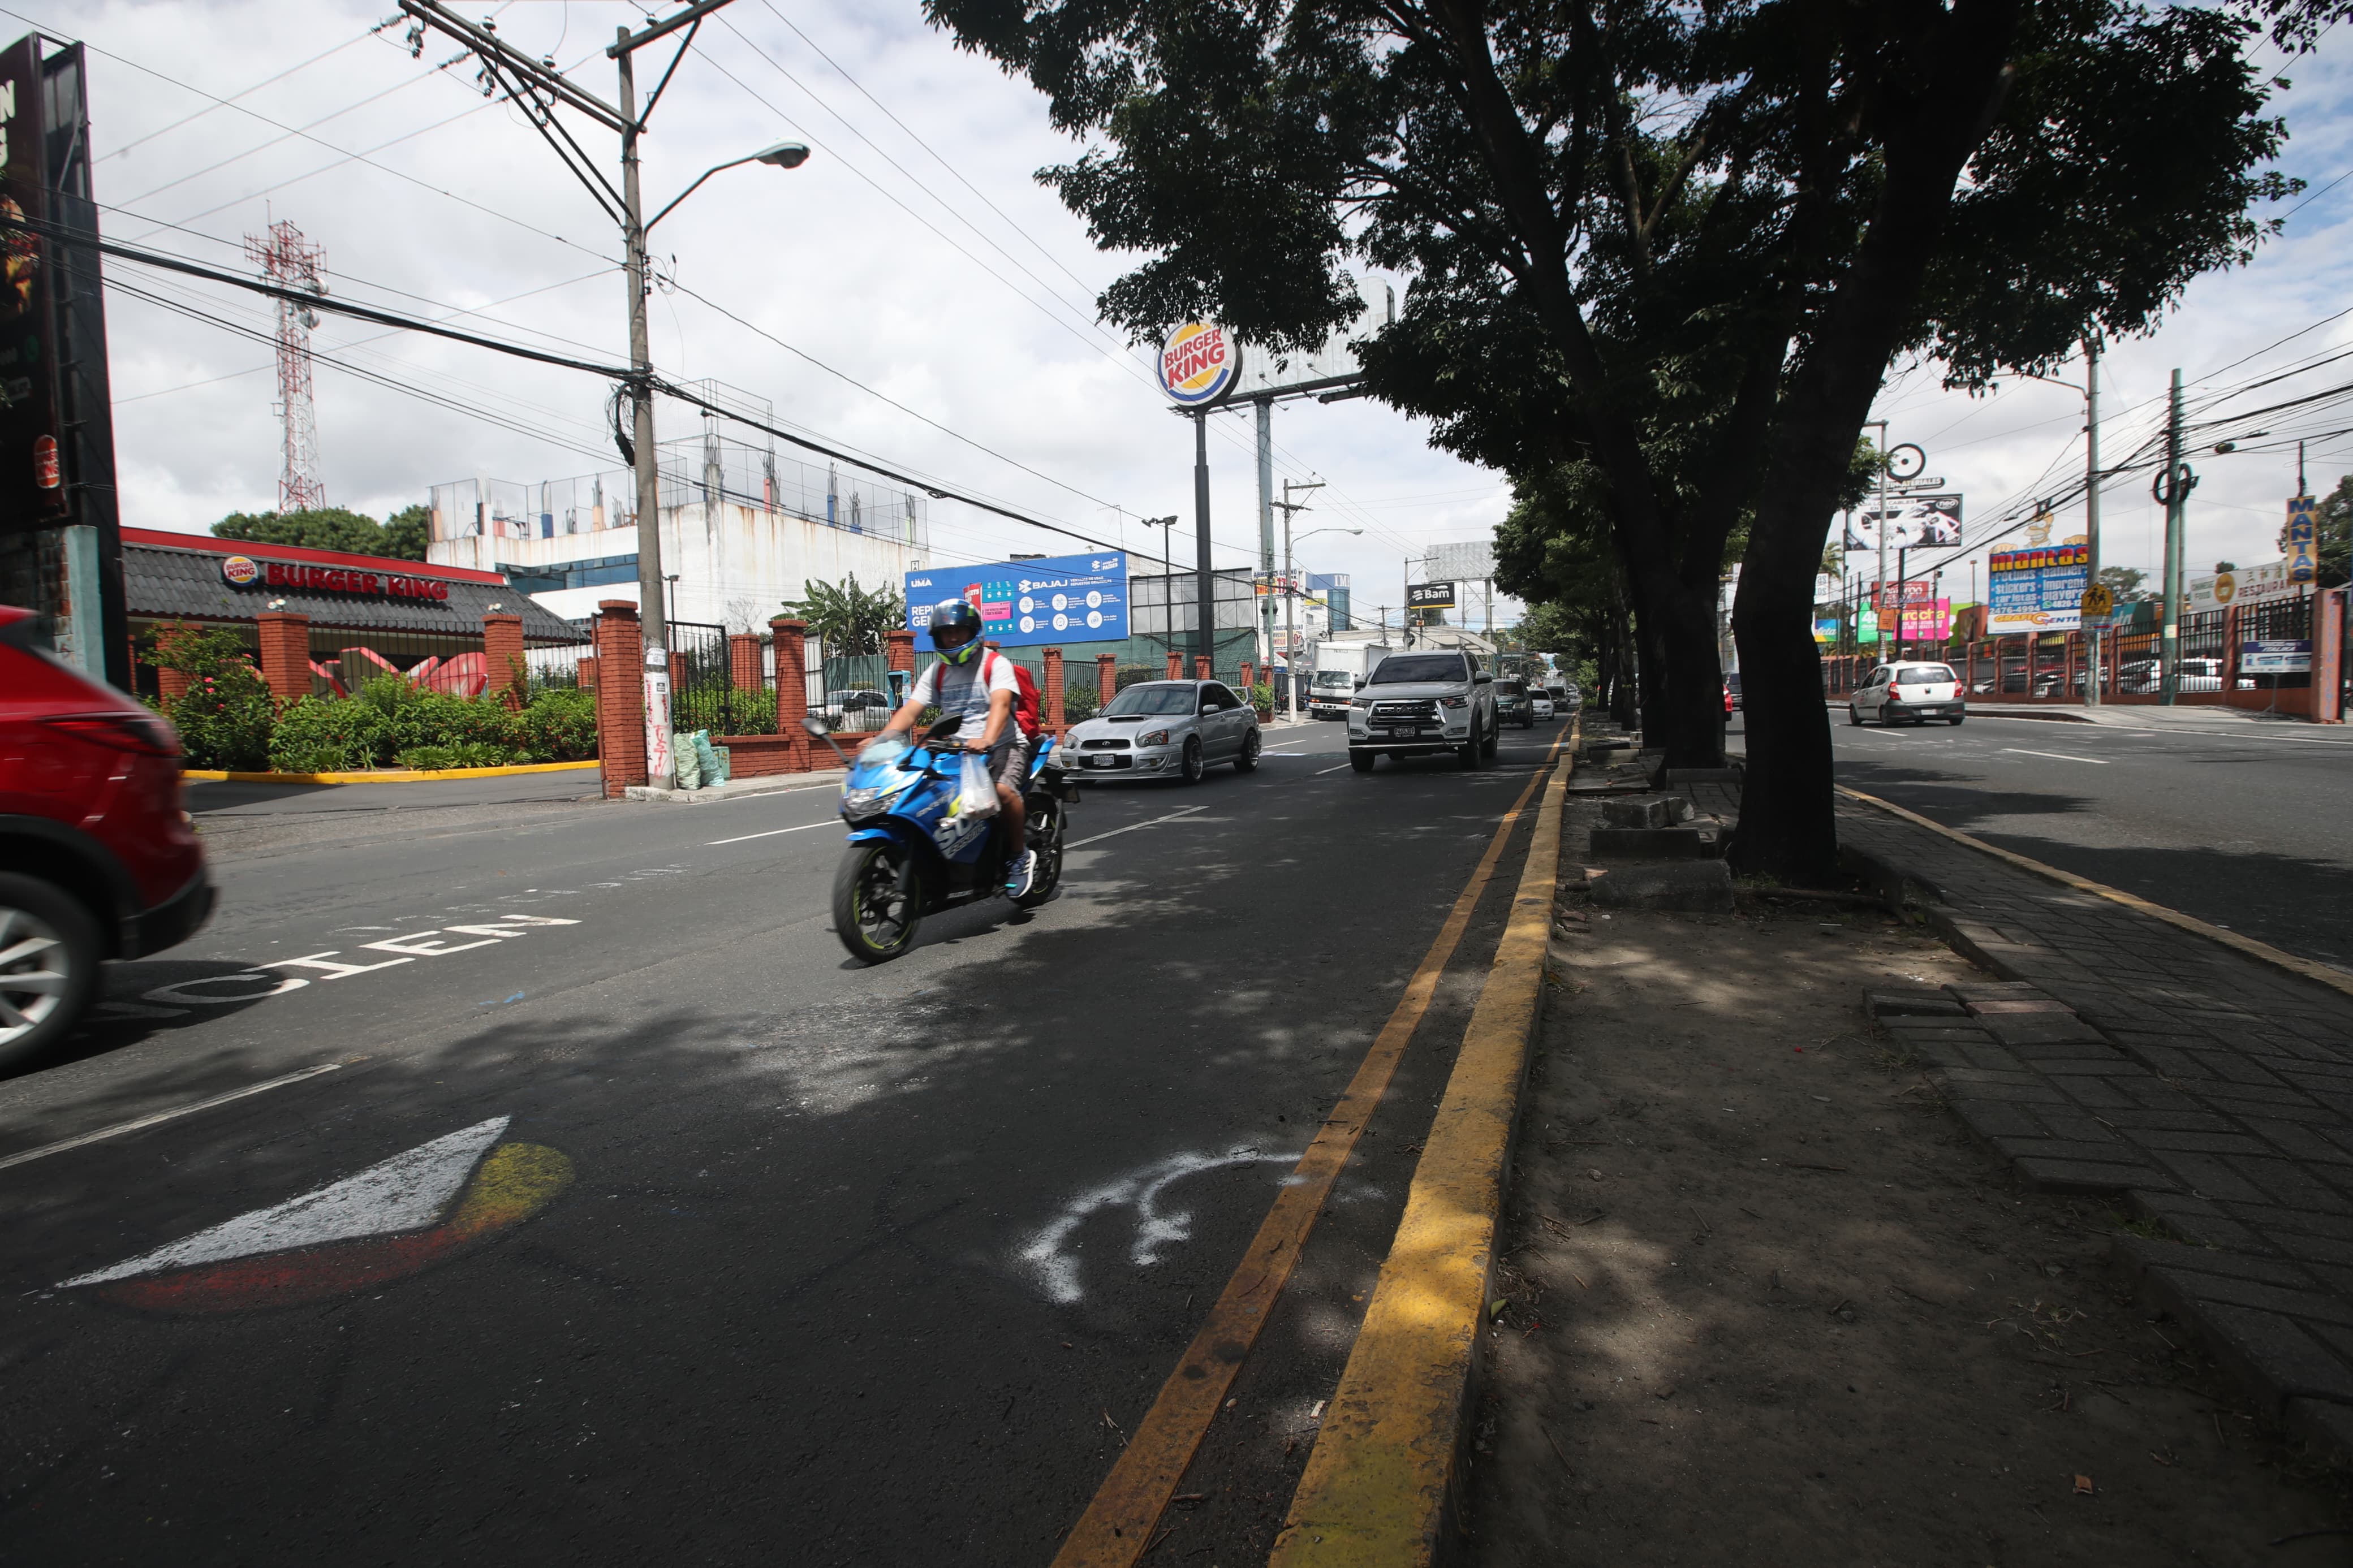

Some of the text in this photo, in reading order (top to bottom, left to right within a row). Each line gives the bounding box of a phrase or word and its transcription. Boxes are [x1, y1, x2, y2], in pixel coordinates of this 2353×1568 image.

[1164, 328, 1222, 369] BURGER
[1167, 343, 1225, 389] KING
[2289, 498, 2315, 582] MANTAS
[226, 561, 254, 570] BURGER
[1991, 546, 2088, 572] mantas
[227, 567, 255, 578] KING
[265, 564, 448, 601] BURGER KING
[1032, 579, 1068, 589] BAJAJ
[1424, 589, 1450, 599] Bam
[1989, 604, 2041, 615] 2476-4994
